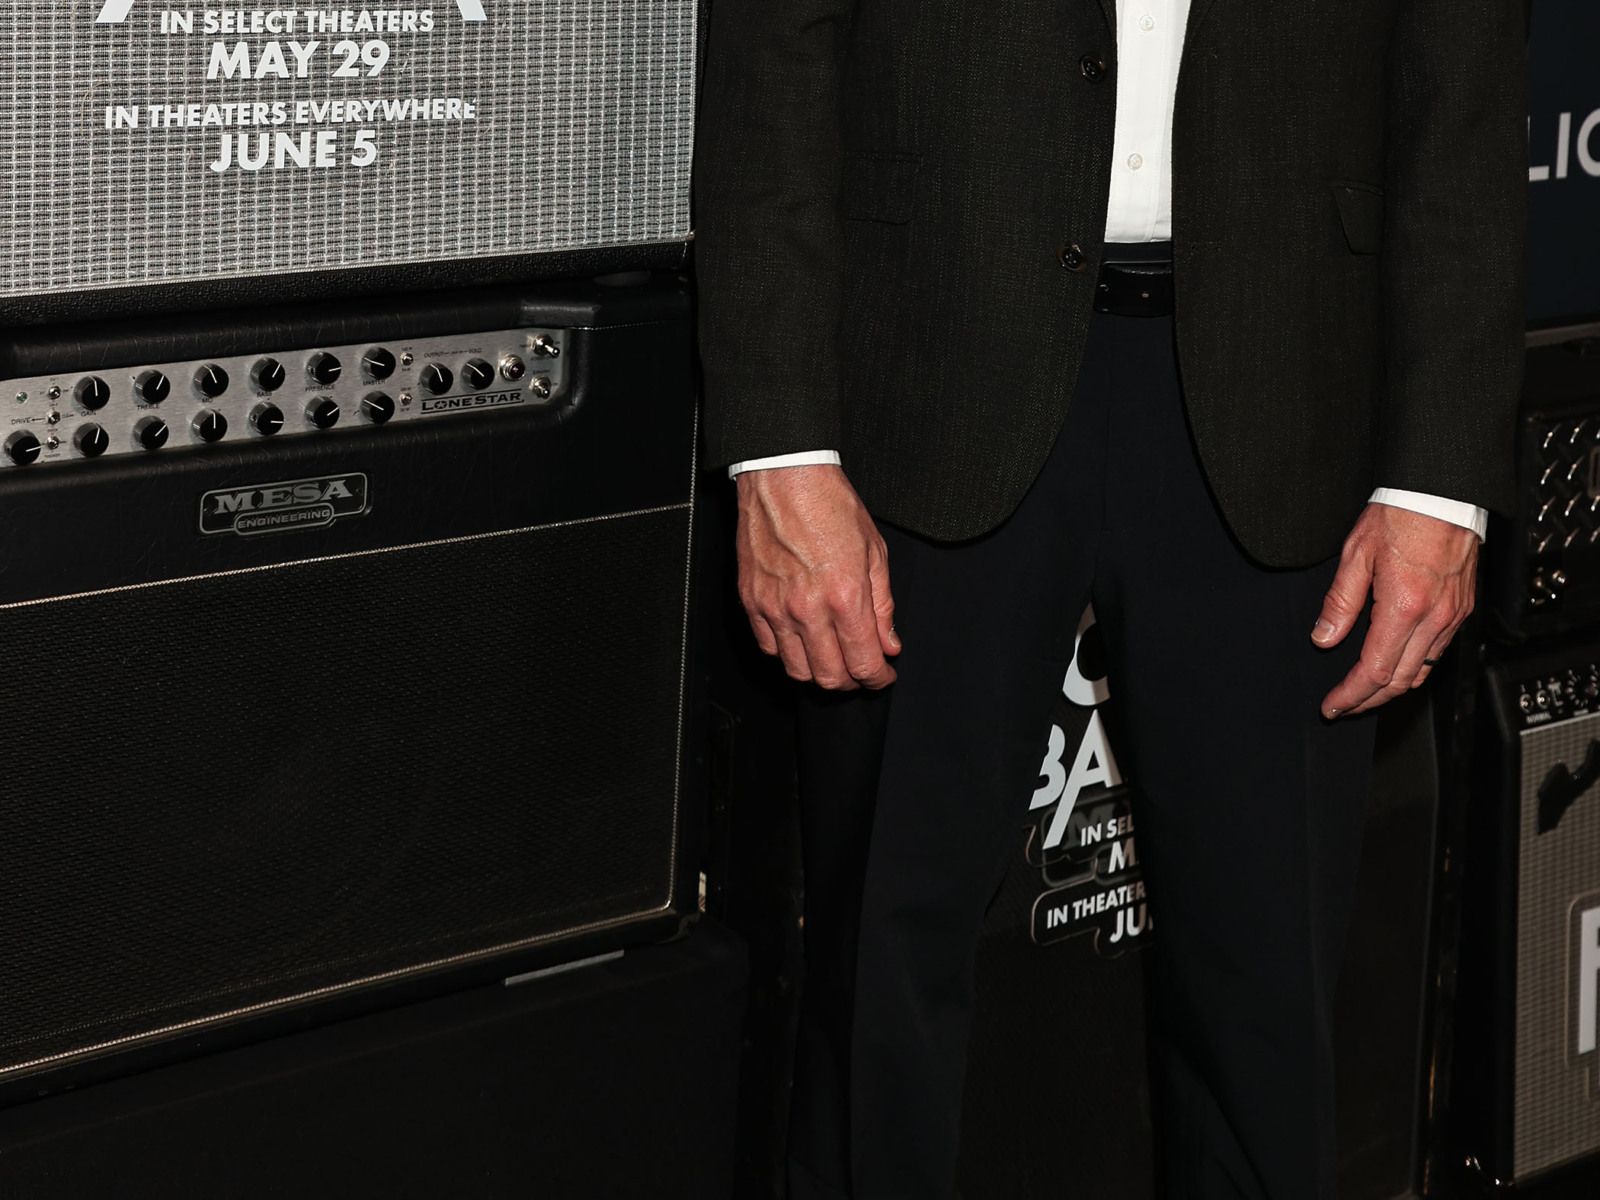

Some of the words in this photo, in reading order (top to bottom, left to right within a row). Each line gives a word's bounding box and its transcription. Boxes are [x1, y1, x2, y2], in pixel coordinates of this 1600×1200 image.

[160, 11, 194, 34] IN
[203, 10, 298, 34] SELECT
[306, 10, 435, 33] THEATERS
[207, 41, 320, 80] MAY
[331, 39, 391, 78] 29
[105, 106, 139, 129] IN
[149, 102, 287, 128] THEATERS
[295, 97, 477, 124] EVERYWHERE
[210, 131, 338, 173] JUNE
[350, 130, 377, 168] 5
[214, 480, 353, 514] MESA
[238, 509, 330, 529] ENGINEERING
[1081, 823, 1102, 847] IN
[1047, 904, 1068, 929] IN
